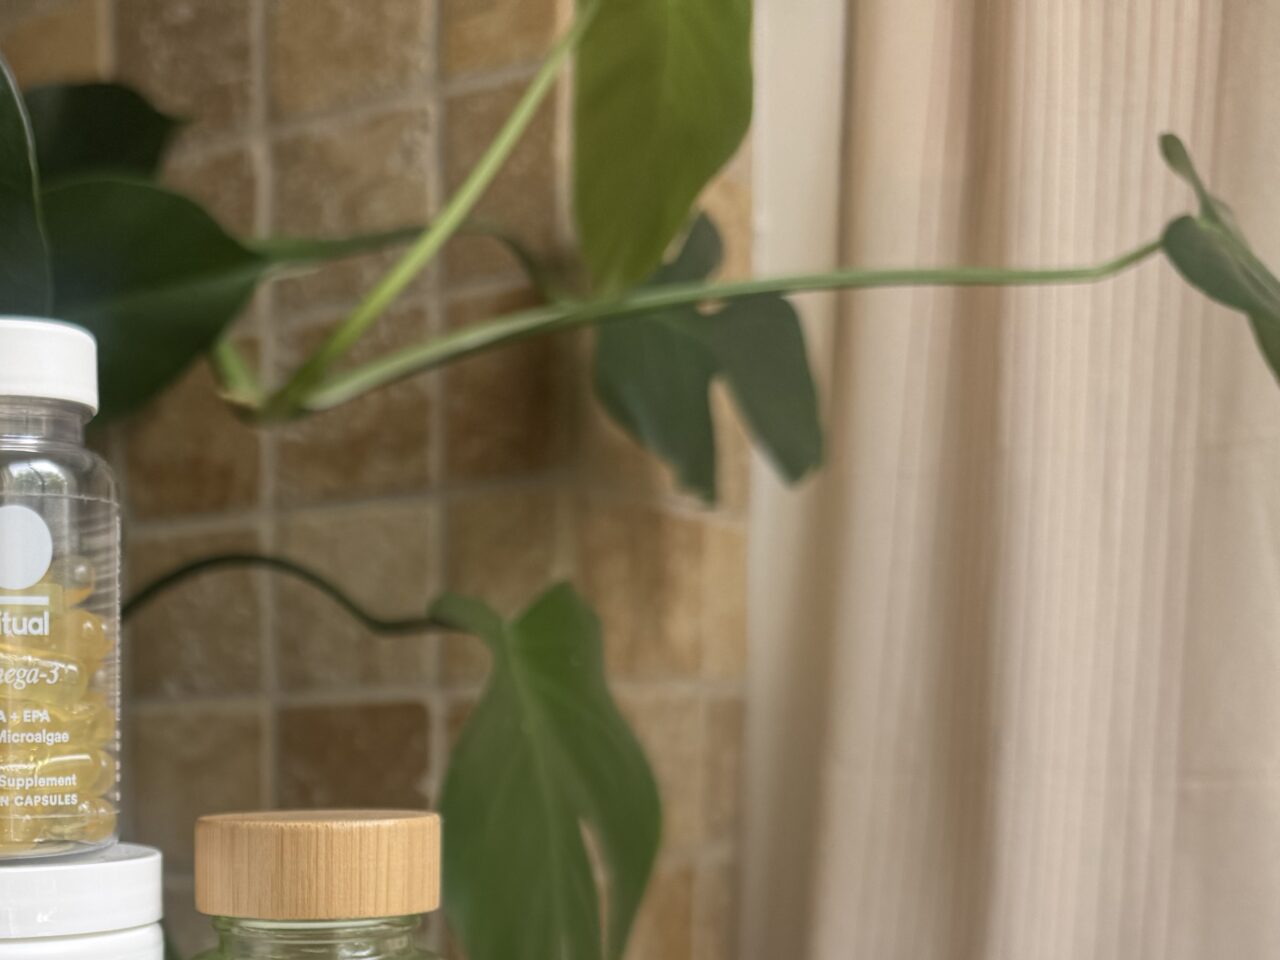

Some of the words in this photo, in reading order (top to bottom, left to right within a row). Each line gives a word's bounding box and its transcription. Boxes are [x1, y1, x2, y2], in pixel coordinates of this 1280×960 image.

[10, 711, 20, 722] +
[23, 709, 51, 723] EPA
[14, 794, 79, 807] CAPSULES
